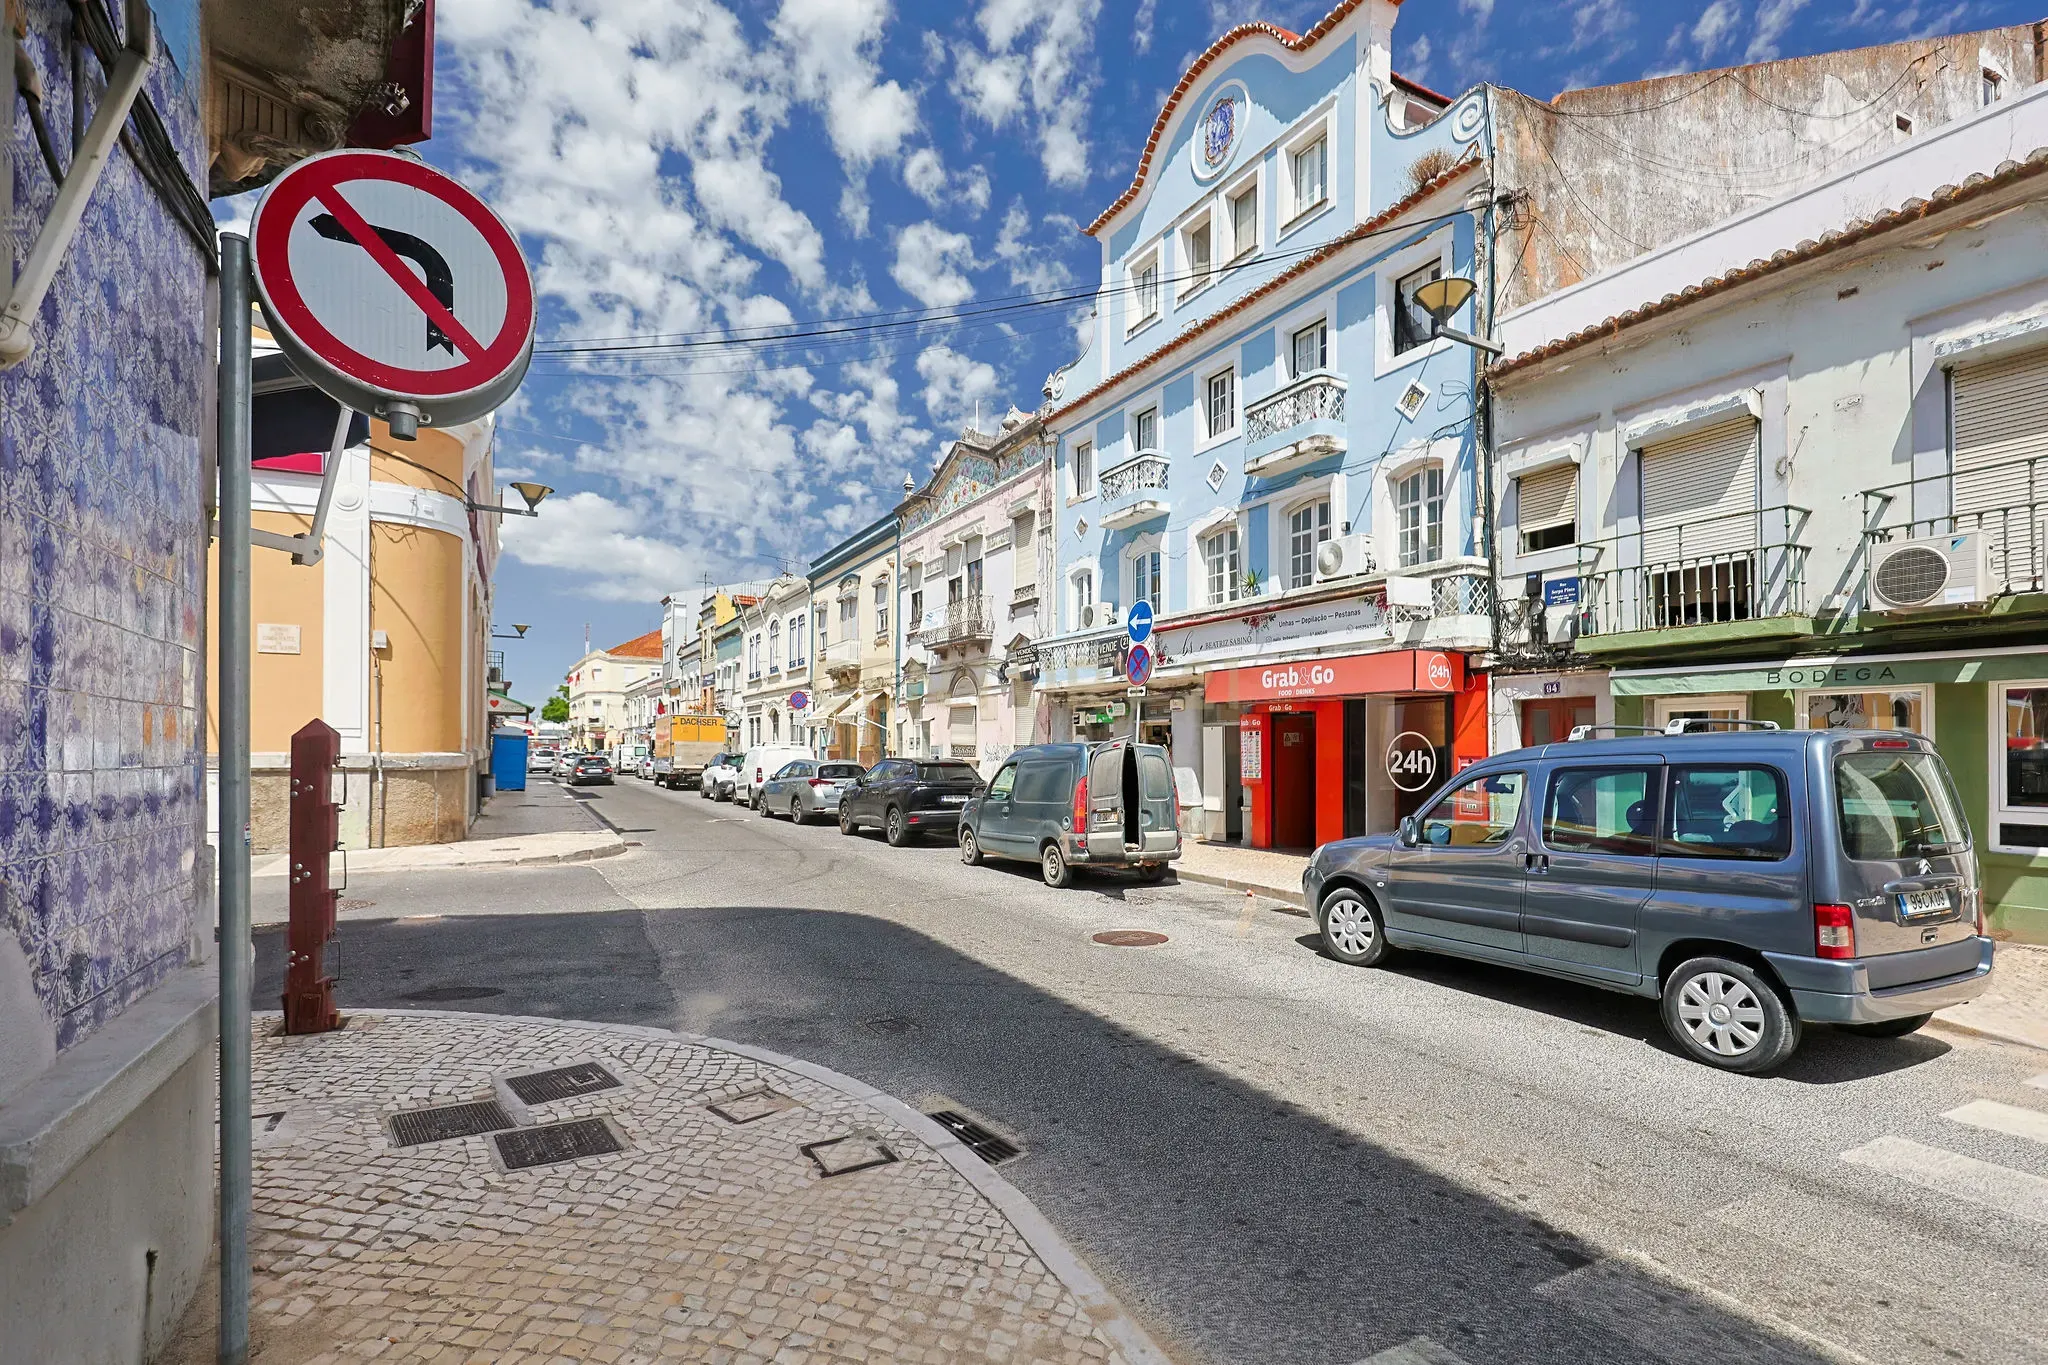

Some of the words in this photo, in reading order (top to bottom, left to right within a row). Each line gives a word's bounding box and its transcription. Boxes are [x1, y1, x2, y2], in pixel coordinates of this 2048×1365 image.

[1278, 620, 1294, 628] Unhas
[1301, 614, 1327, 625] Depilação
[1334, 609, 1361, 619] Pestanas
[1205, 639, 1229, 650] BEATRIZ
[1230, 636, 1252, 646] SABINO
[1430, 664, 1449, 678] 24h
[1767, 666, 1896, 683] BODEGA
[680, 718, 717, 726] DACHSER
[1390, 750, 1432, 774] 24h
